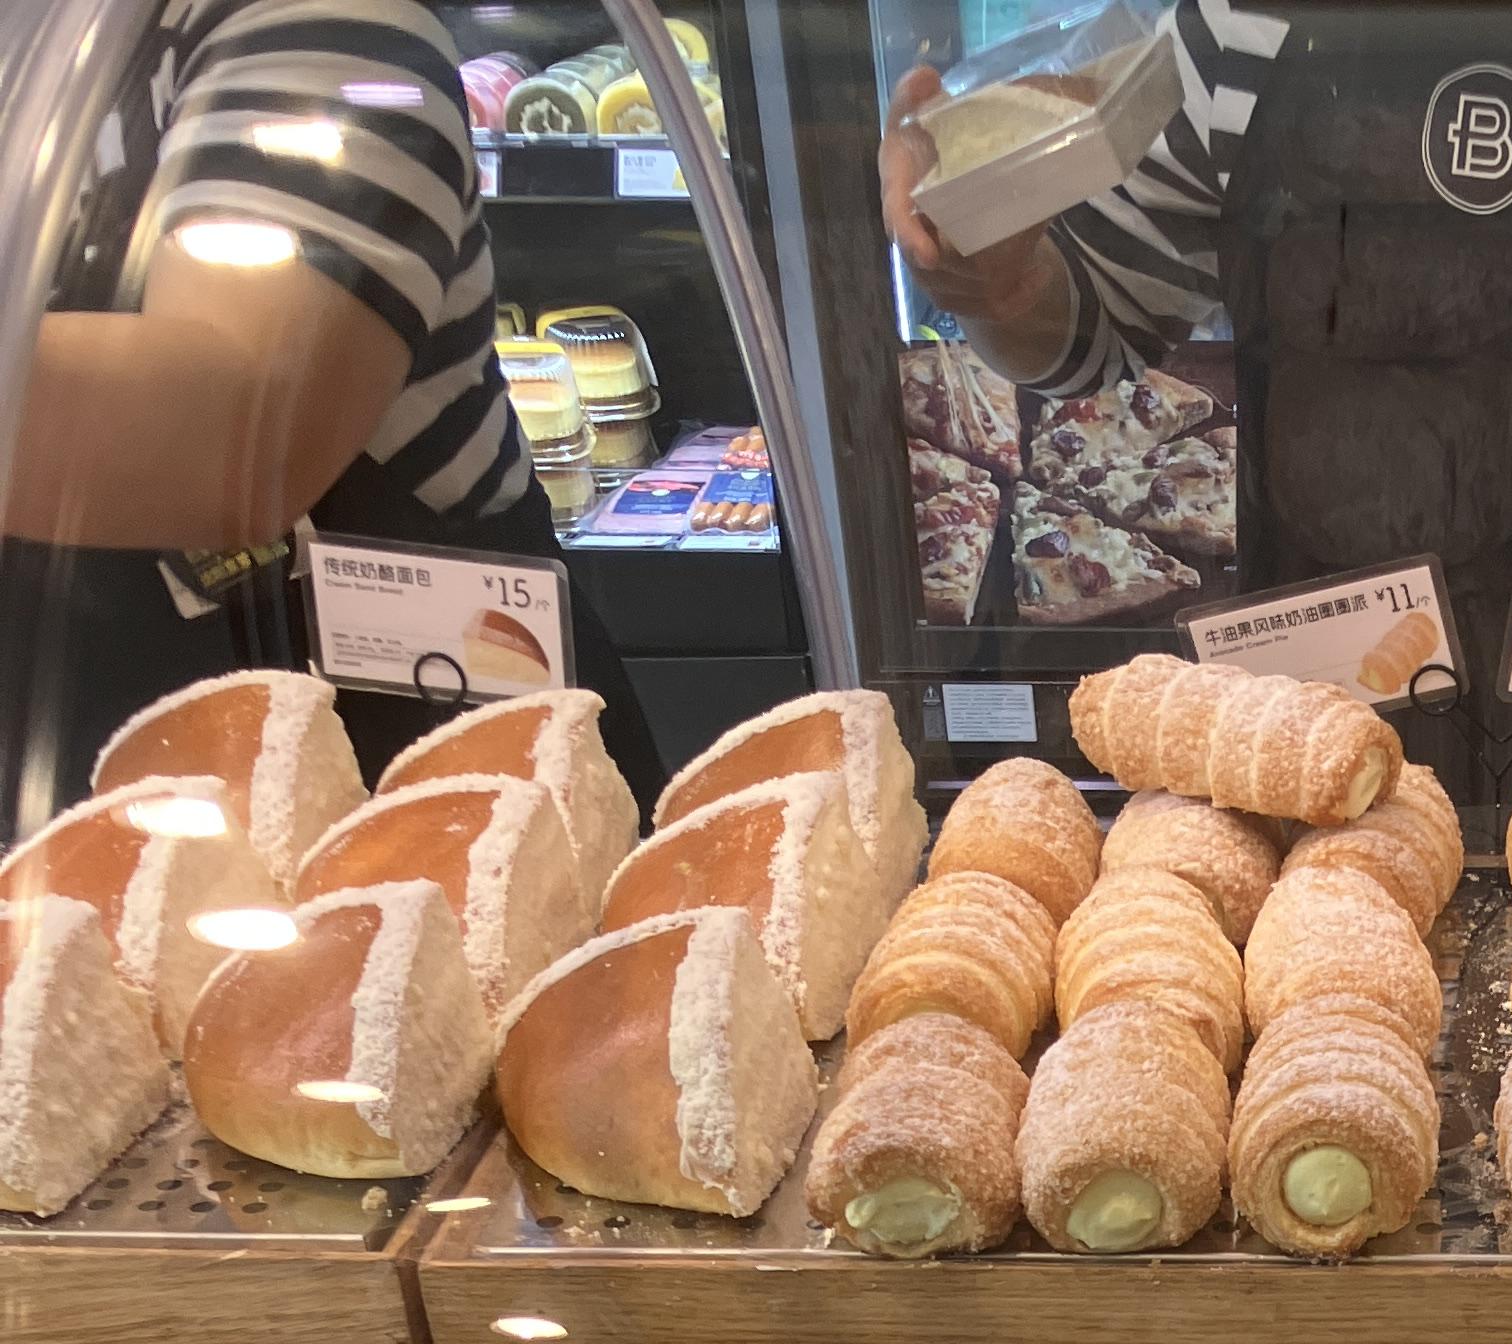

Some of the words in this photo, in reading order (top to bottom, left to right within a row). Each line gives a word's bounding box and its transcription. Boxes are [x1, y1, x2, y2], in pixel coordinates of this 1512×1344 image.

[322, 556, 432, 588] 传统奶酪面包
[1204, 593, 1369, 647] 牛油果风味奶油圈圈派
